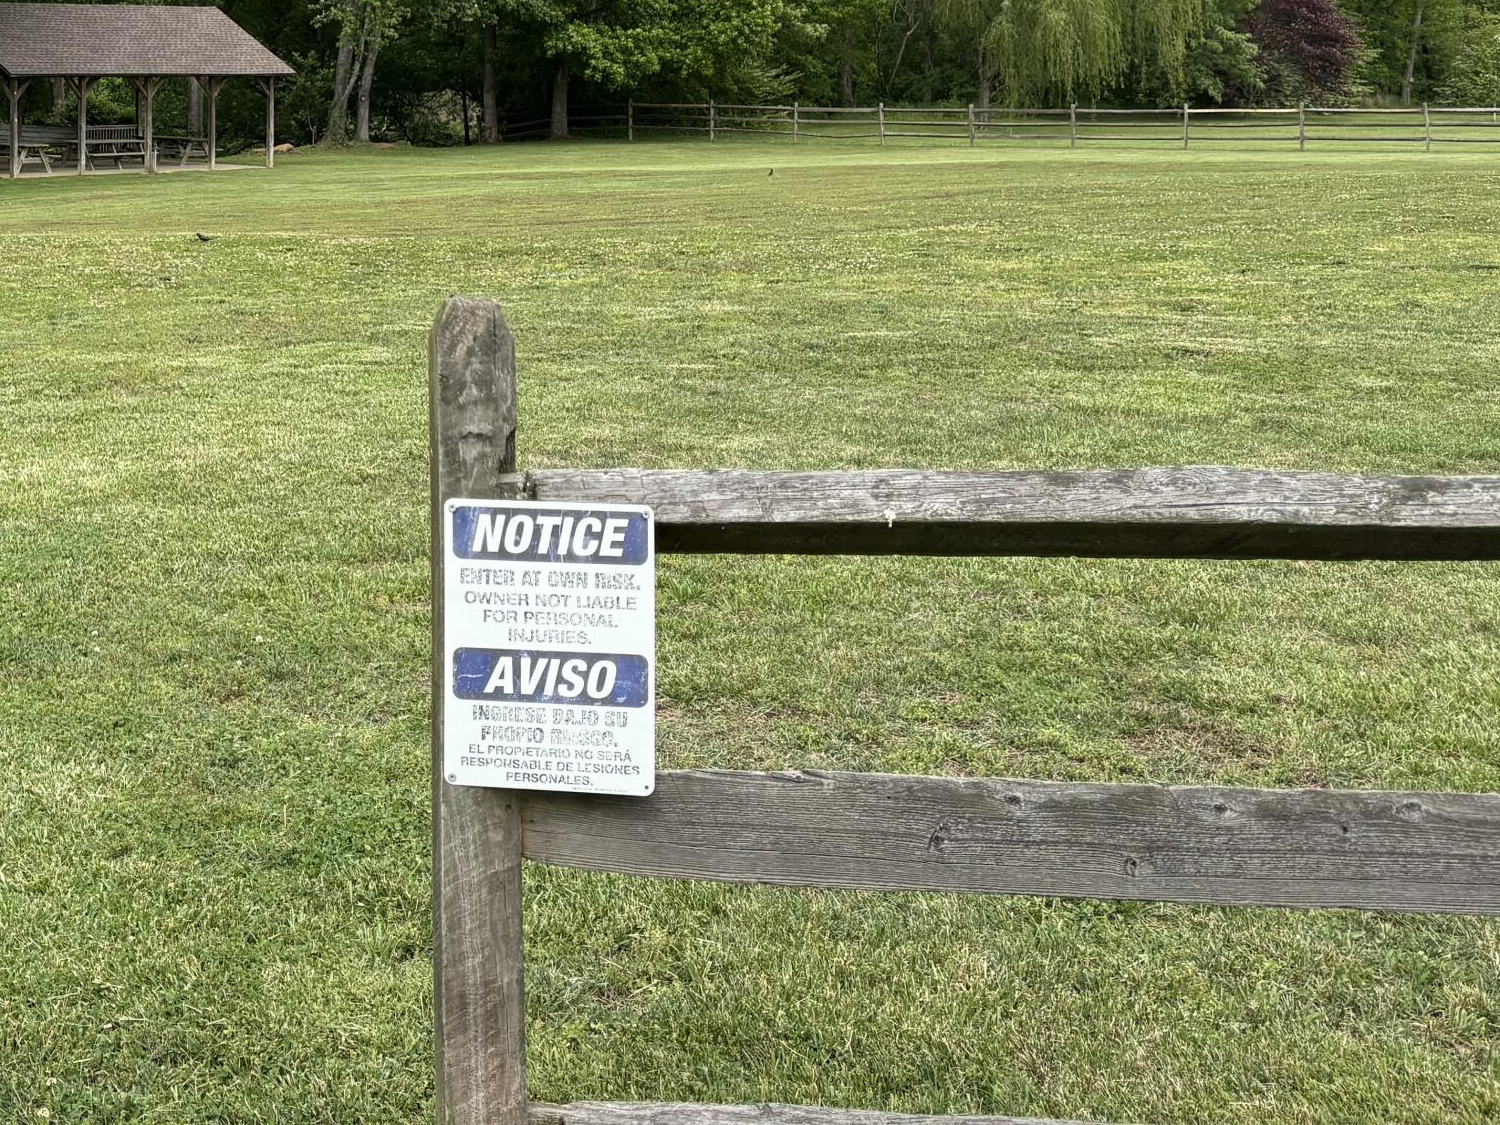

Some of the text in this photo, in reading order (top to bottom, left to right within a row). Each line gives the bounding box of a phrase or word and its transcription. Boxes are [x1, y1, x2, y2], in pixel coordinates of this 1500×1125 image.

[472, 513, 629, 557] NOTICE
[460, 567, 515, 586] ENTER
[521, 570, 542, 587] AT
[548, 571, 588, 589] OWN
[464, 590, 637, 611] OWNER NOT LIABLE
[483, 609, 619, 628] FOR PERSONAL
[508, 628, 592, 645] INJURIES.
[483, 656, 618, 698] AVISO
[468, 744, 632, 762] EL PROPIETARIO NO SERÁ
[460, 756, 640, 775] RESPONSABLE DE LESIONES
[506, 771, 594, 786] PERSONALES.
